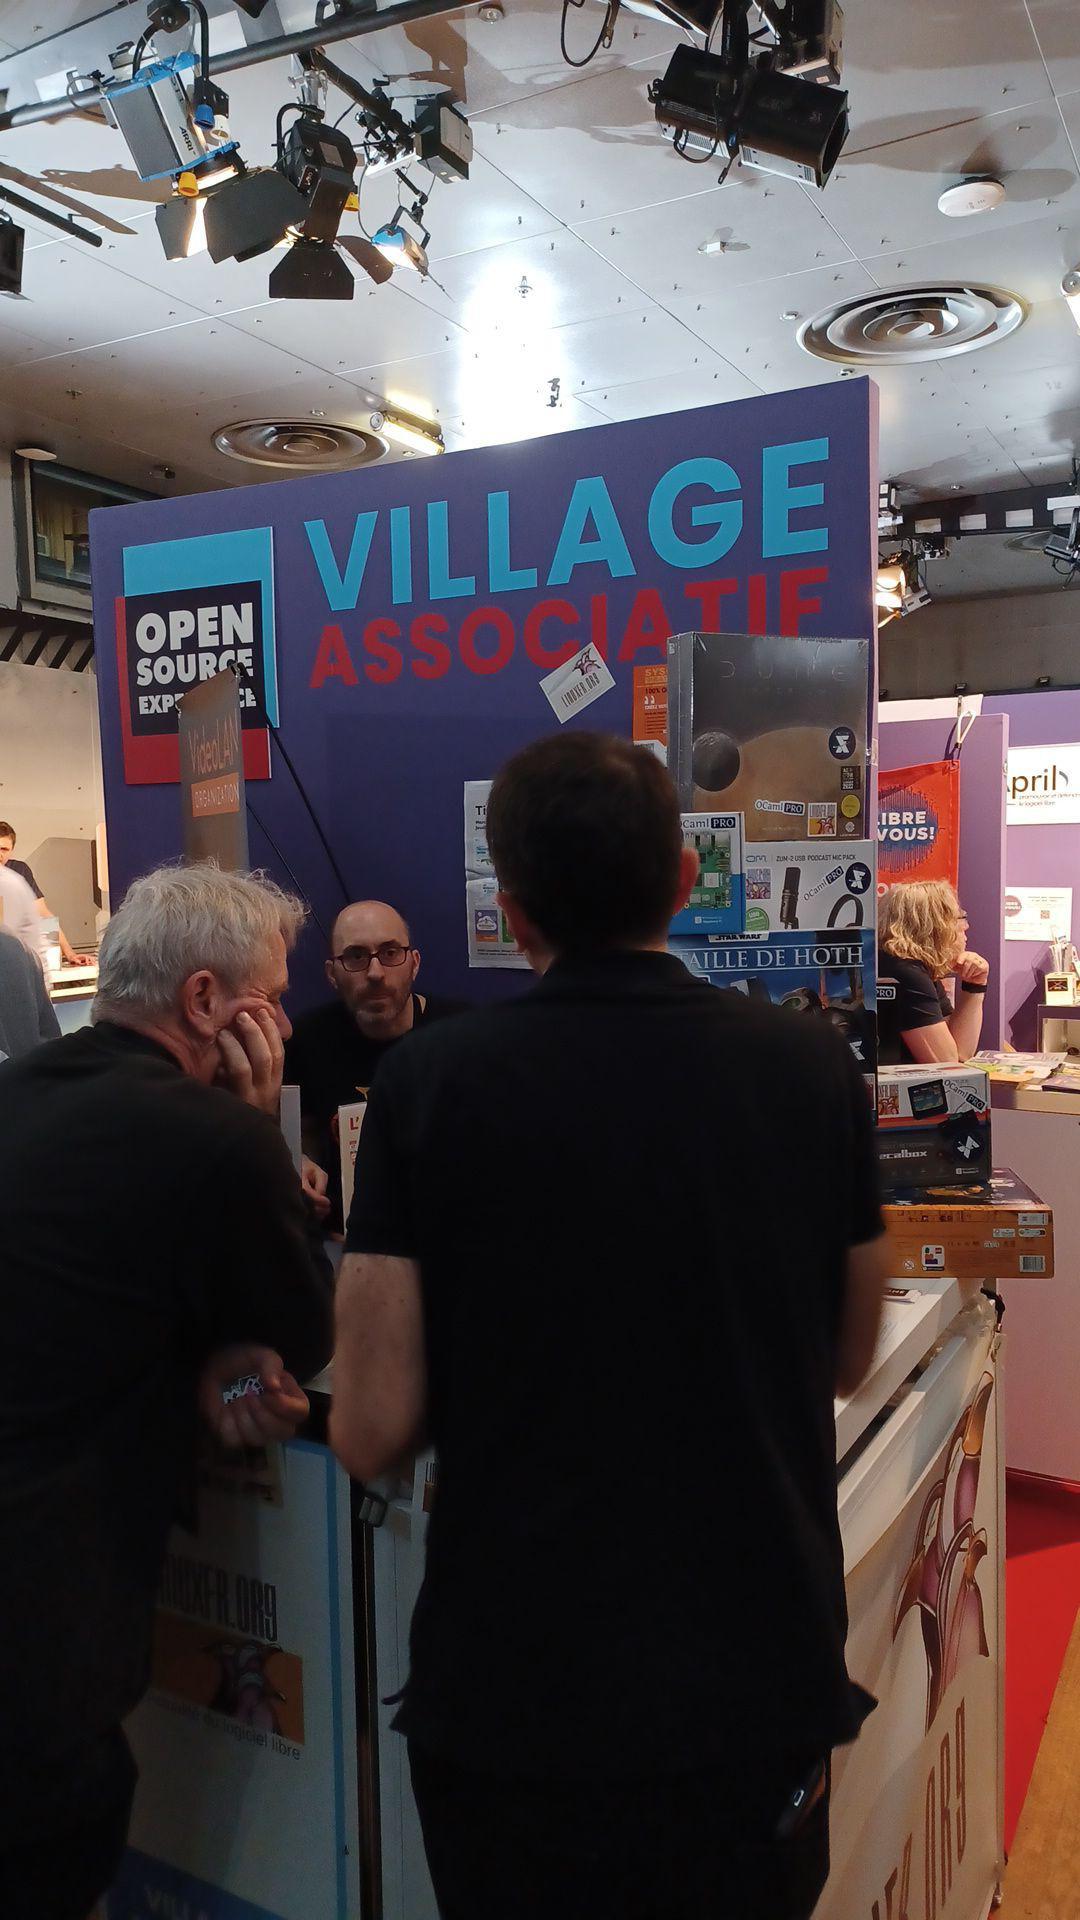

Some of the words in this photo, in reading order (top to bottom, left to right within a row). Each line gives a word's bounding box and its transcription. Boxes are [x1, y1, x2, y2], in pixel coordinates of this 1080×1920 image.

[179, 126, 194, 151] ARRI
[304, 437, 829, 611] VILLAGE
[135, 602, 254, 653] OPEN
[309, 568, 829, 689] ASSOCIATIF
[188, 711, 239, 776] VideoLAN
[194, 782, 240, 809] ORGANIZATION
[1007, 765, 1057, 800] pril
[877, 826, 935, 842] VOUS!
[878, 811, 926, 826] IBRE
[756, 949, 785, 968] DE
[794, 946, 864, 967] HOTH
[223, 1715, 268, 1750] logiciel
[271, 1730, 301, 1761] libre
